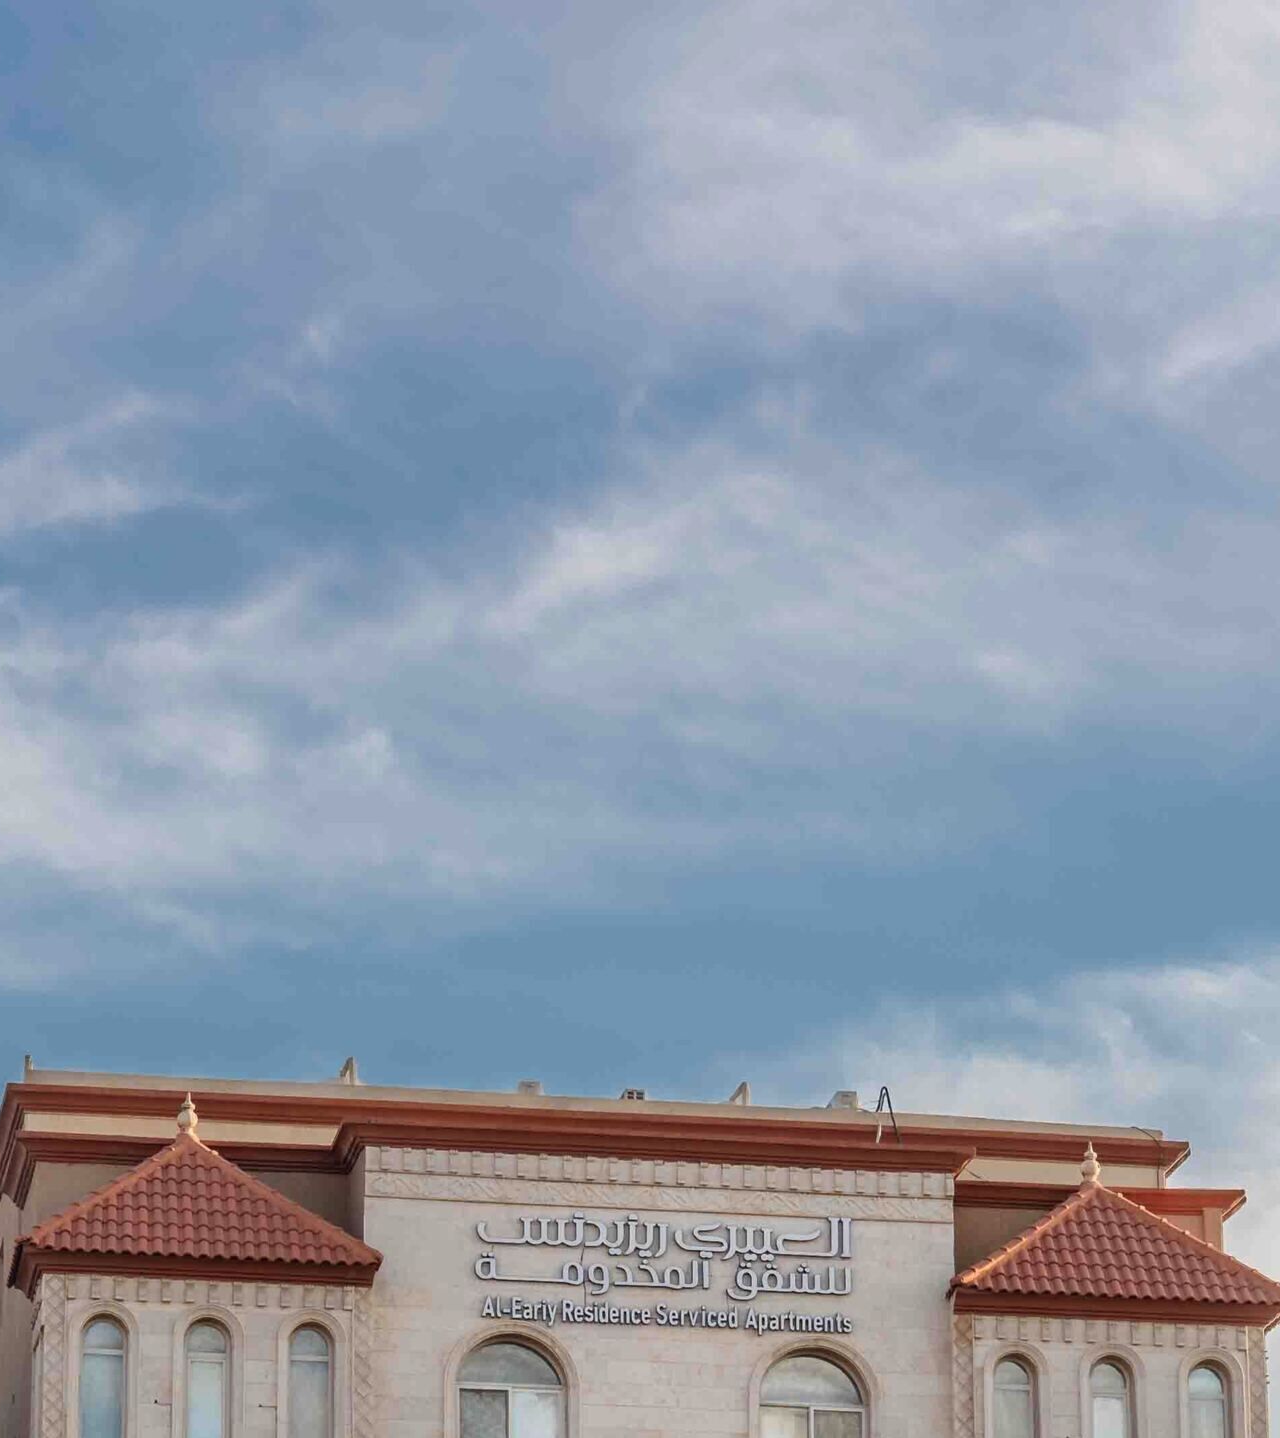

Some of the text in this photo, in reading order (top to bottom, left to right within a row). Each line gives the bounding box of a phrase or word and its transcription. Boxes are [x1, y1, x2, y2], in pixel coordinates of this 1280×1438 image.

[474, 1251, 852, 1301] للشقق المخدومة
[481, 1296, 853, 1335] Al-Eariy Residence Serviced Apartments
